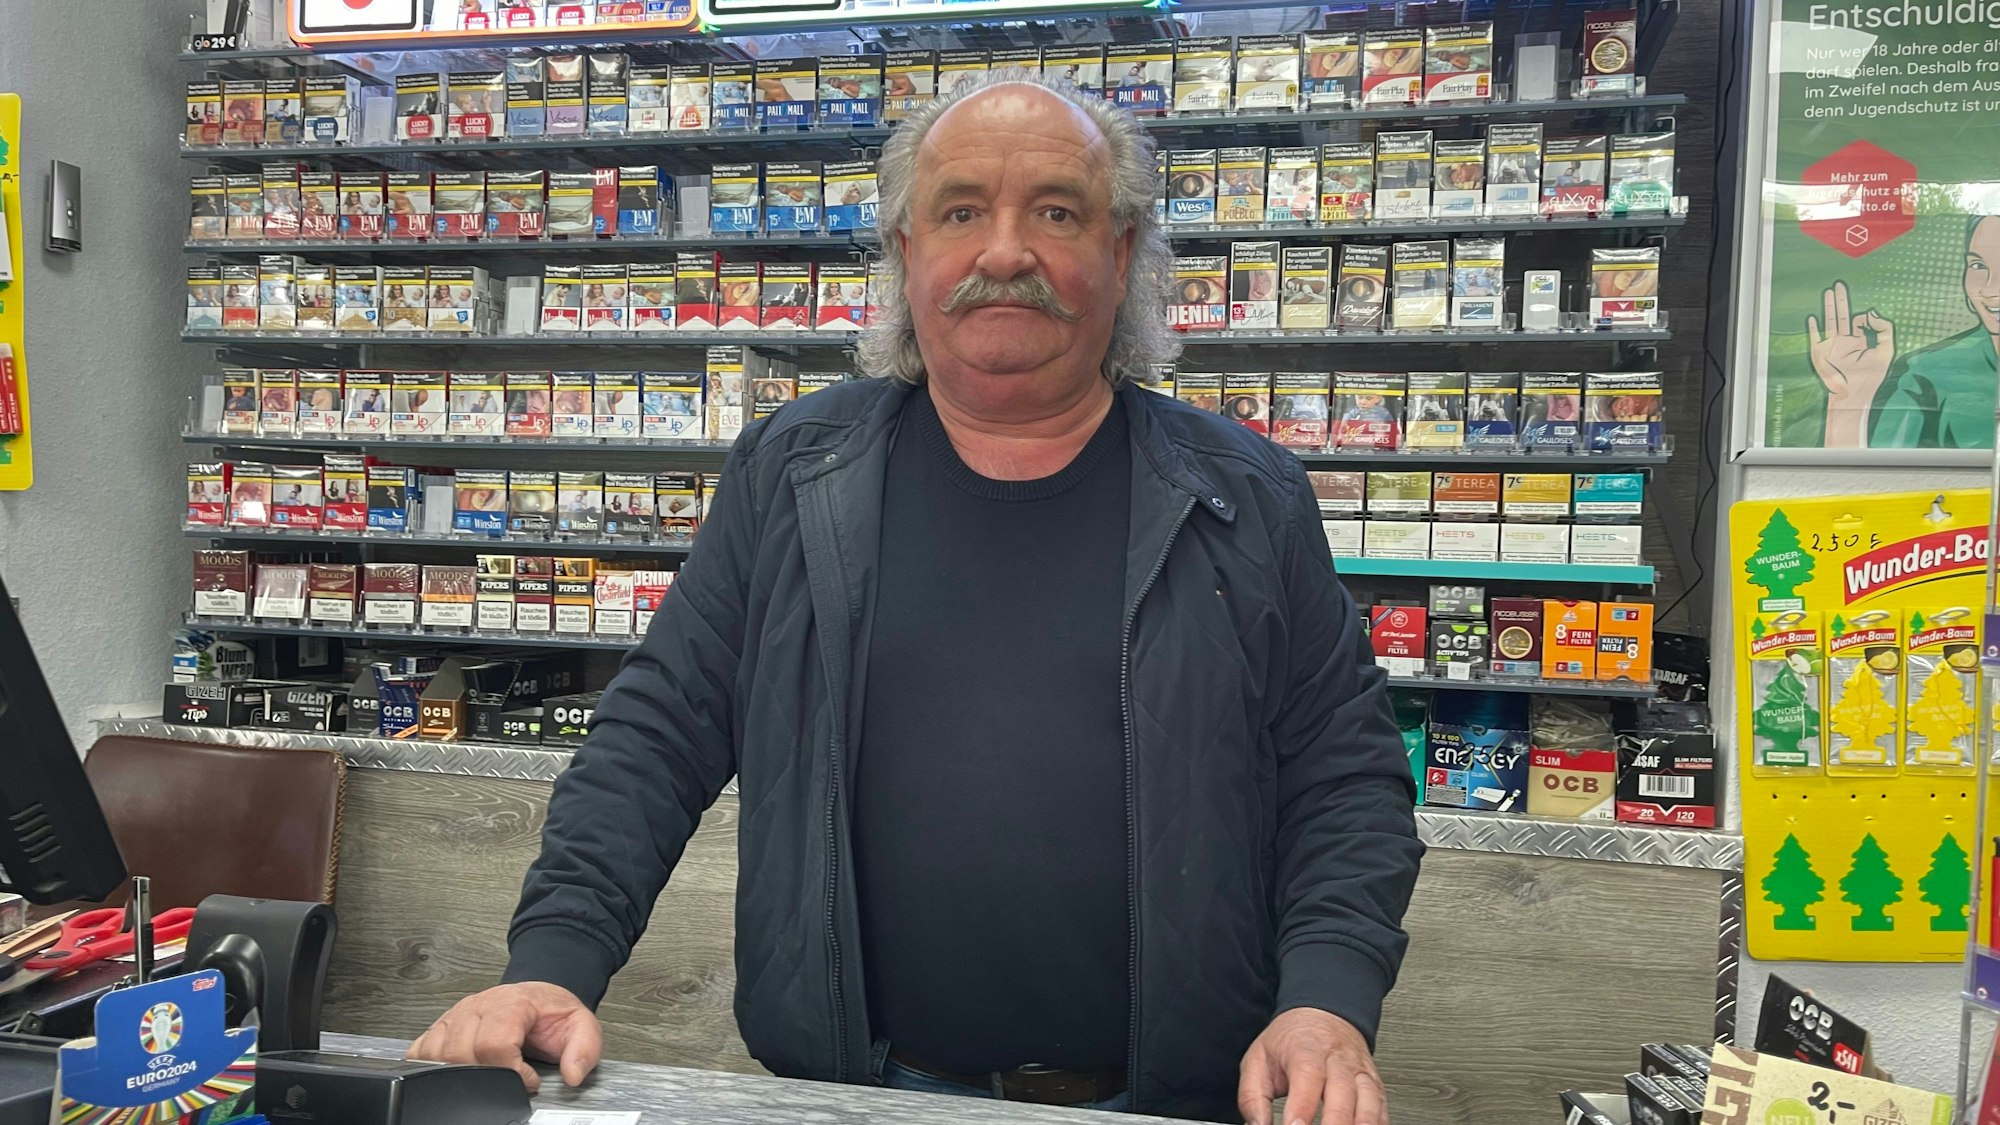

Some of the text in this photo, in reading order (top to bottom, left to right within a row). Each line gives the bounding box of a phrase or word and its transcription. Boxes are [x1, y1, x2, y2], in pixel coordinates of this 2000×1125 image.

[1807, 40, 1980, 60] Nur wer 18 Jahre oder
[1805, 66, 1840, 79] darf
[1843, 64, 1903, 81] spielen.
[1907, 60, 1971, 76] Deshalb
[1442, 84, 1473, 95] FairPlay
[1805, 86, 1824, 99] im
[1828, 83, 1886, 98] Zweifel
[1890, 81, 1929, 95] nach
[1932, 79, 1968, 93] dem
[1118, 89, 1159, 103] PALL MALL
[715, 107, 749, 118] PALL MALL
[767, 105, 804, 116] PALL MALL
[831, 102, 869, 114] PALL MALL
[1804, 99, 1980, 119] denn Jugendschutz ist
[465, 117, 487, 126] LUCKY
[464, 125, 487, 134] STRIKE
[1830, 172, 1888, 183] Mehr zum
[1549, 192, 1596, 208] ELIXYR
[518, 212, 541, 231] L&M
[631, 208, 655, 227] L&M
[732, 207, 755, 225] L&M
[793, 206, 816, 225] L&M
[358, 214, 381, 232] L&M
[406, 214, 428, 232] L&M
[459, 213, 481, 231] L&M
[721, 414, 740, 426] EVE
[1322, 476, 1361, 487] TEREA
[1387, 476, 1426, 488] TEREA
[1455, 477, 1496, 489] TEREA
[1526, 479, 1567, 491] TEREA
[335, 513, 364, 524] Winston
[378, 516, 403, 526] Winston
[474, 518, 502, 530] Winston
[525, 519, 551, 530] Winston
[572, 519, 598, 530] Winston
[623, 520, 650, 532] Winston
[1367, 529, 1407, 538] HEETS
[1435, 530, 1476, 539] HEETS
[1505, 532, 1546, 541] HEETS
[1575, 533, 1617, 541] HEETS
[200, 556, 241, 566] MOODS
[1756, 550, 1802, 566] WUNDER-
[1845, 533, 1990, 594] Wunder-Ba
[1771, 559, 1801, 572] BAUM
[262, 570, 300, 580] MOODS
[317, 571, 348, 580] MOODS
[429, 571, 470, 581] MOODS
[634, 570, 674, 586] DENIM
[480, 581, 510, 590] PIPERS
[519, 582, 548, 591] PIPERS
[558, 584, 588, 593] PIPERS
[597, 587, 631, 604] Chesterfield
[1436, 585, 1479, 600] OCB
[481, 605, 508, 613] Rauchen
[520, 606, 547, 614] Rauchen
[559, 608, 586, 616] Rauchen
[488, 612, 509, 620] tödlich
[528, 613, 548, 622] tödlich
[566, 615, 588, 624] tödlich
[1555, 623, 1567, 640] 8
[1571, 630, 1592, 640] FEIN
[1436, 633, 1483, 650] OCB
[1570, 638, 1593, 646] FILTER
[1601, 637, 1624, 645] FILTER
[1752, 632, 1816, 653] Wunder-Baum
[1831, 631, 1896, 651] Wunder-Baum
[1909, 628, 1974, 649] Wunder-Baum
[1387, 647, 1409, 655] FILTER
[1601, 643, 1622, 652] FEIN
[1626, 643, 1639, 659] 8
[216, 646, 248, 664] Blunt
[221, 662, 255, 681] Wrap
[185, 685, 226, 700] GIZEH
[513, 680, 538, 696] OCB
[286, 690, 326, 706] GIZEH
[352, 699, 379, 710] OCB
[383, 705, 415, 718] OCB
[423, 705, 451, 718] OCB
[503, 721, 526, 732] OCB
[1432, 732, 1440, 740] 10
[1447, 735, 1460, 743] 100
[1535, 755, 1561, 766] SLIM
[1543, 773, 1600, 793] OCB
[1640, 808, 1655, 817] 20
[1676, 811, 1695, 820] 120
[1789, 995, 1834, 1041] OCB
[146, 1054, 176, 1071] UEFA
[126, 1059, 197, 1089] EURO2024
[141, 1077, 181, 1093] GERMANY
